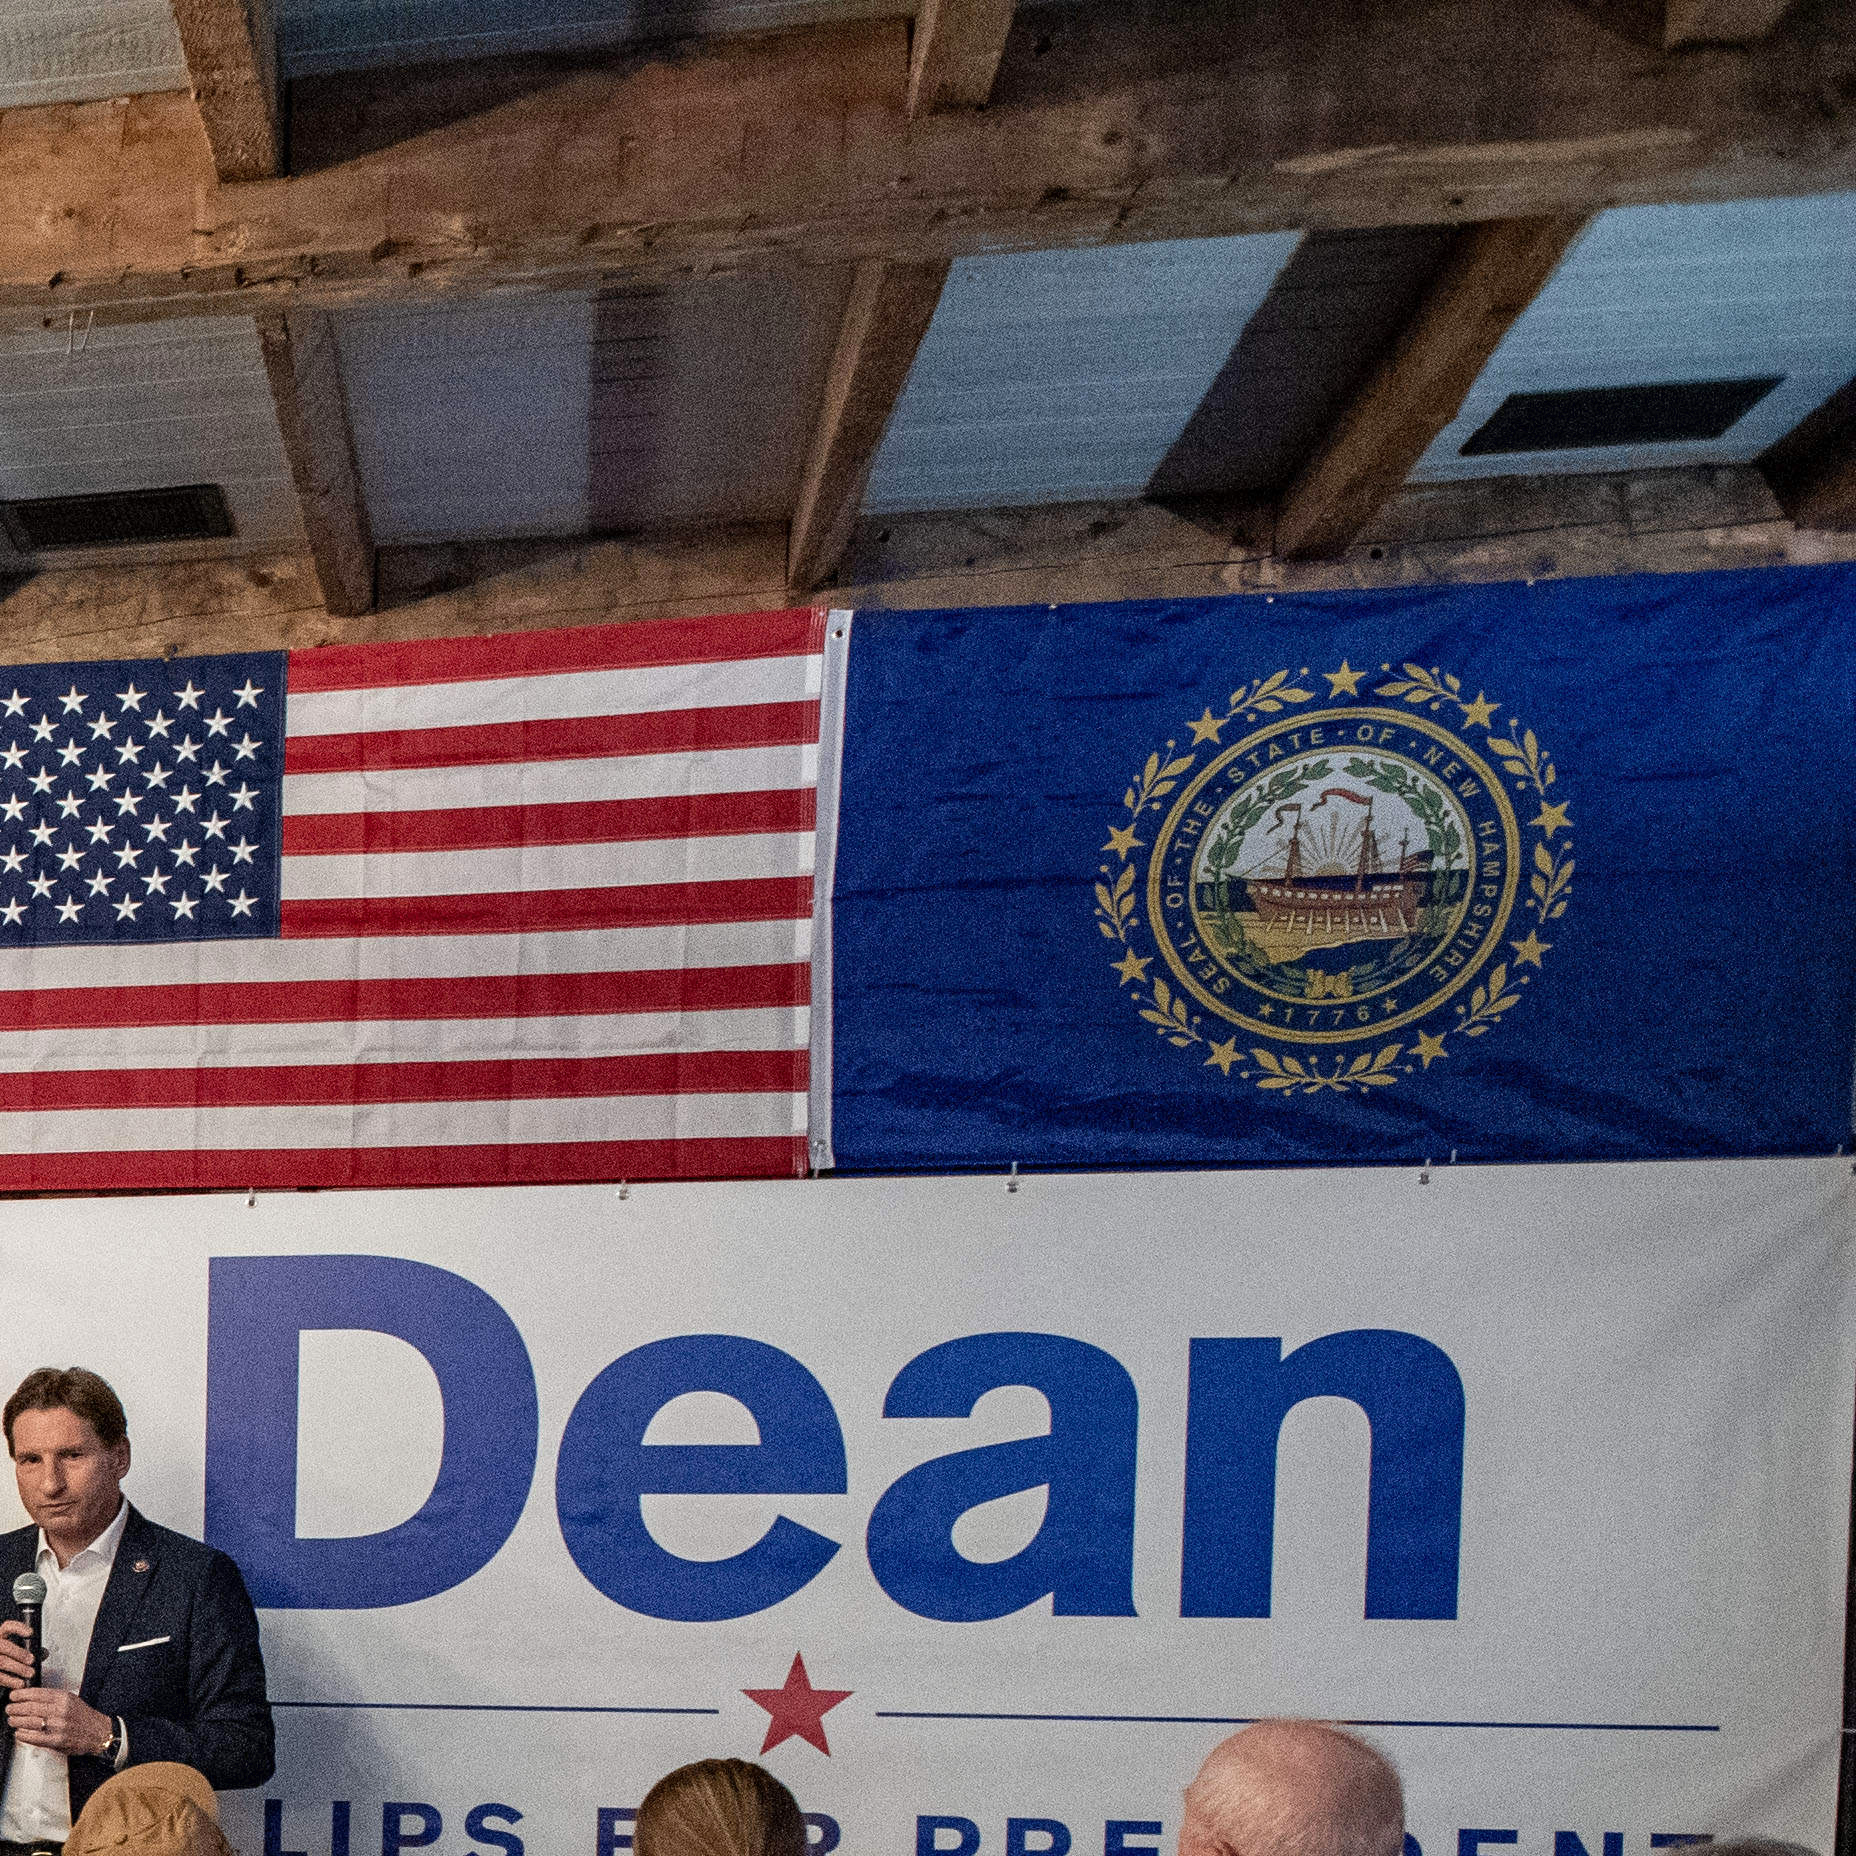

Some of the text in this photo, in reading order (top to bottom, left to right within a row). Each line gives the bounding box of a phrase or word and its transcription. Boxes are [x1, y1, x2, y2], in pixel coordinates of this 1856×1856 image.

[1165, 724, 1499, 994] SEAL OF THE STATE OF NEW HAMPSHIRE
[1283, 1004, 1372, 1027] 1776
[203, 1254, 1466, 1624] Dean
